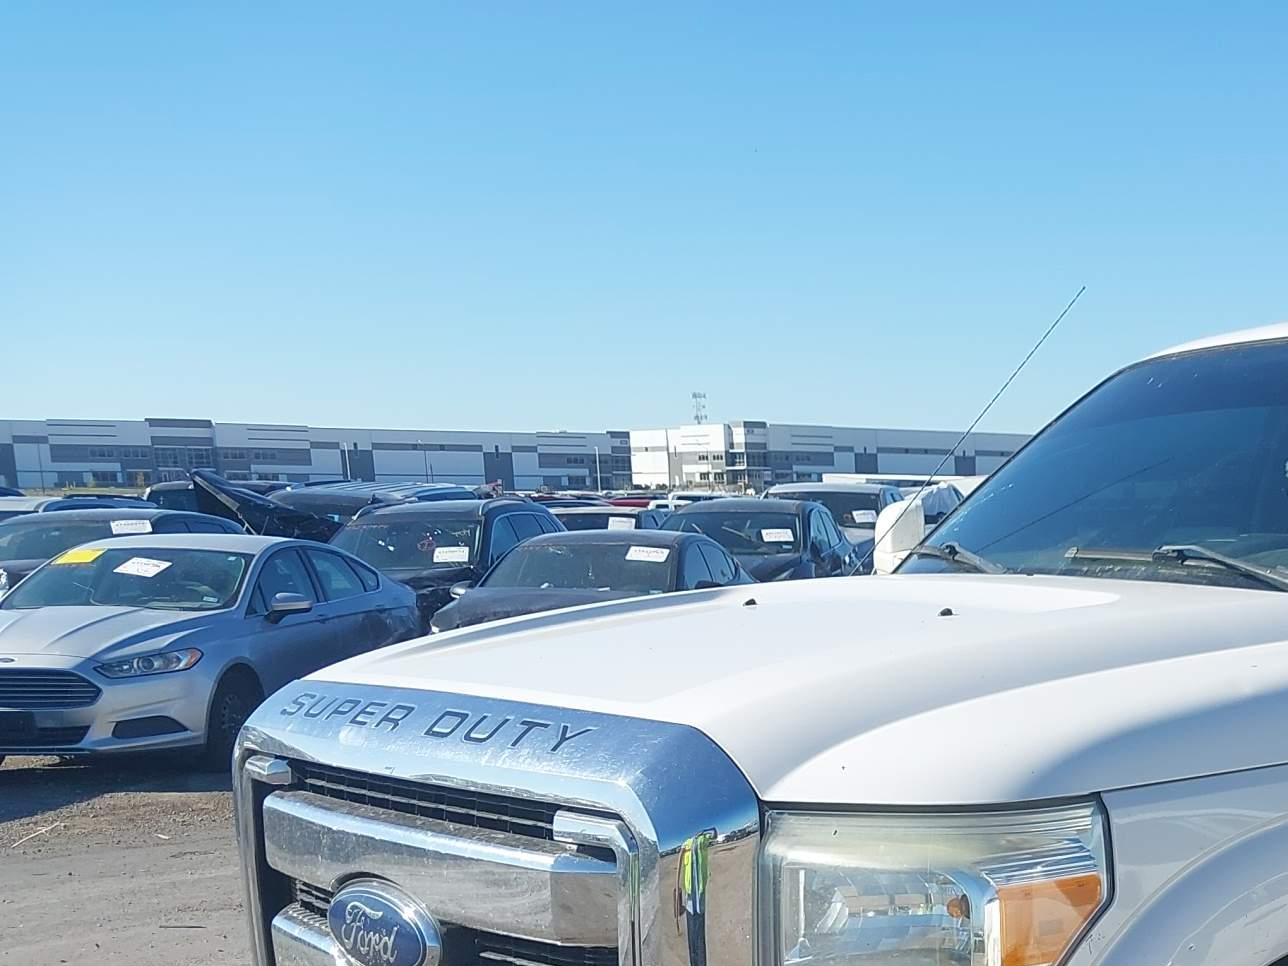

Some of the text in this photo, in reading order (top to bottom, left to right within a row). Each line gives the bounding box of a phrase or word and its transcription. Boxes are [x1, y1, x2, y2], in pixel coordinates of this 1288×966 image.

[279, 691, 599, 753] SUPER DUTY
[340, 900, 401, 964] Ford
